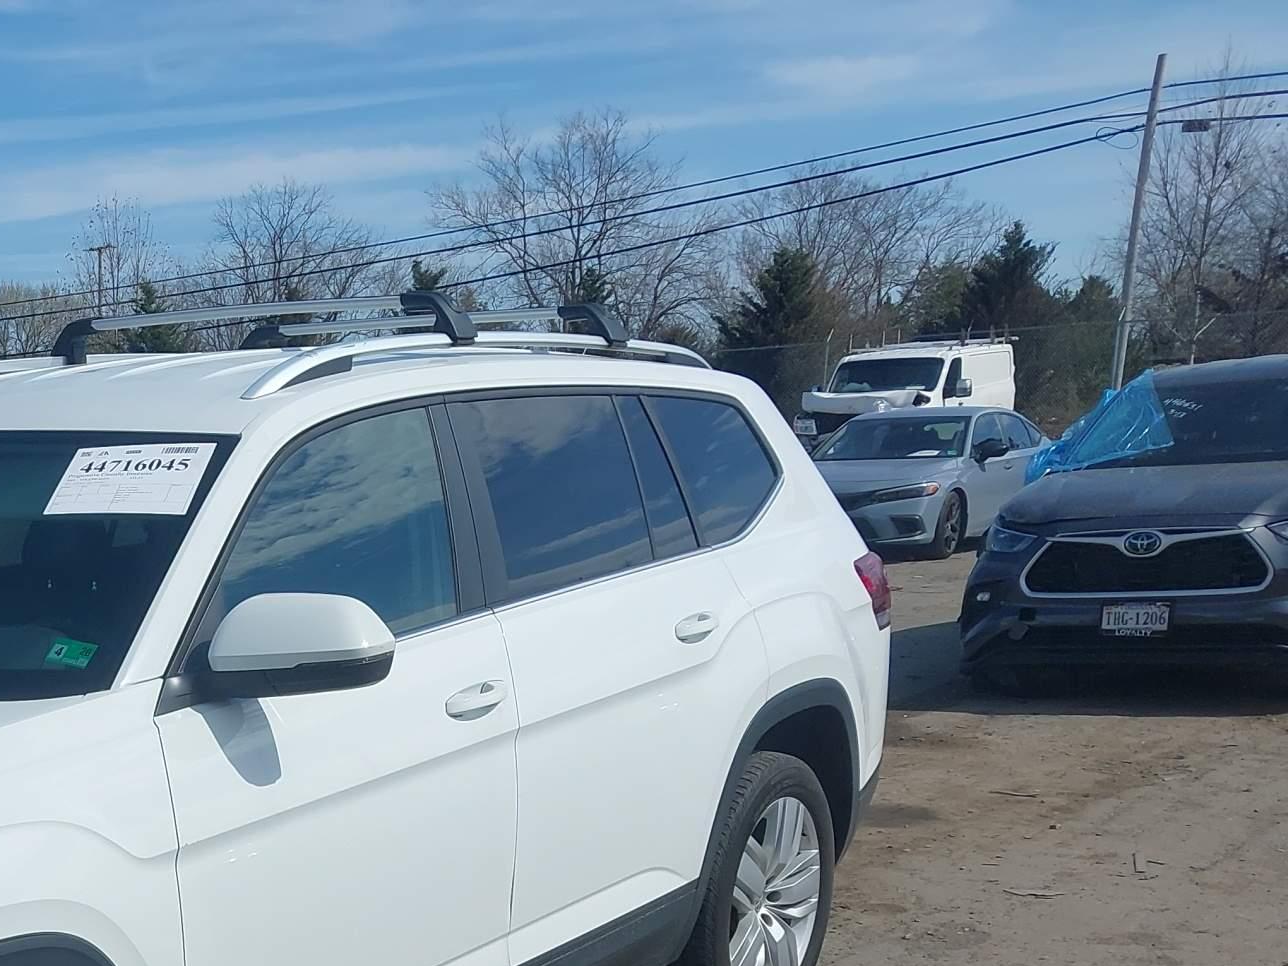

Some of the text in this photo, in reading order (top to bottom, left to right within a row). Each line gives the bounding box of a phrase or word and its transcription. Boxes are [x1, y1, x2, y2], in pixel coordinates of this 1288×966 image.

[80, 458, 191, 473] 44716045
[1105, 611, 1167, 626] THG-1206
[1115, 628, 1153, 637] LOYALTY
